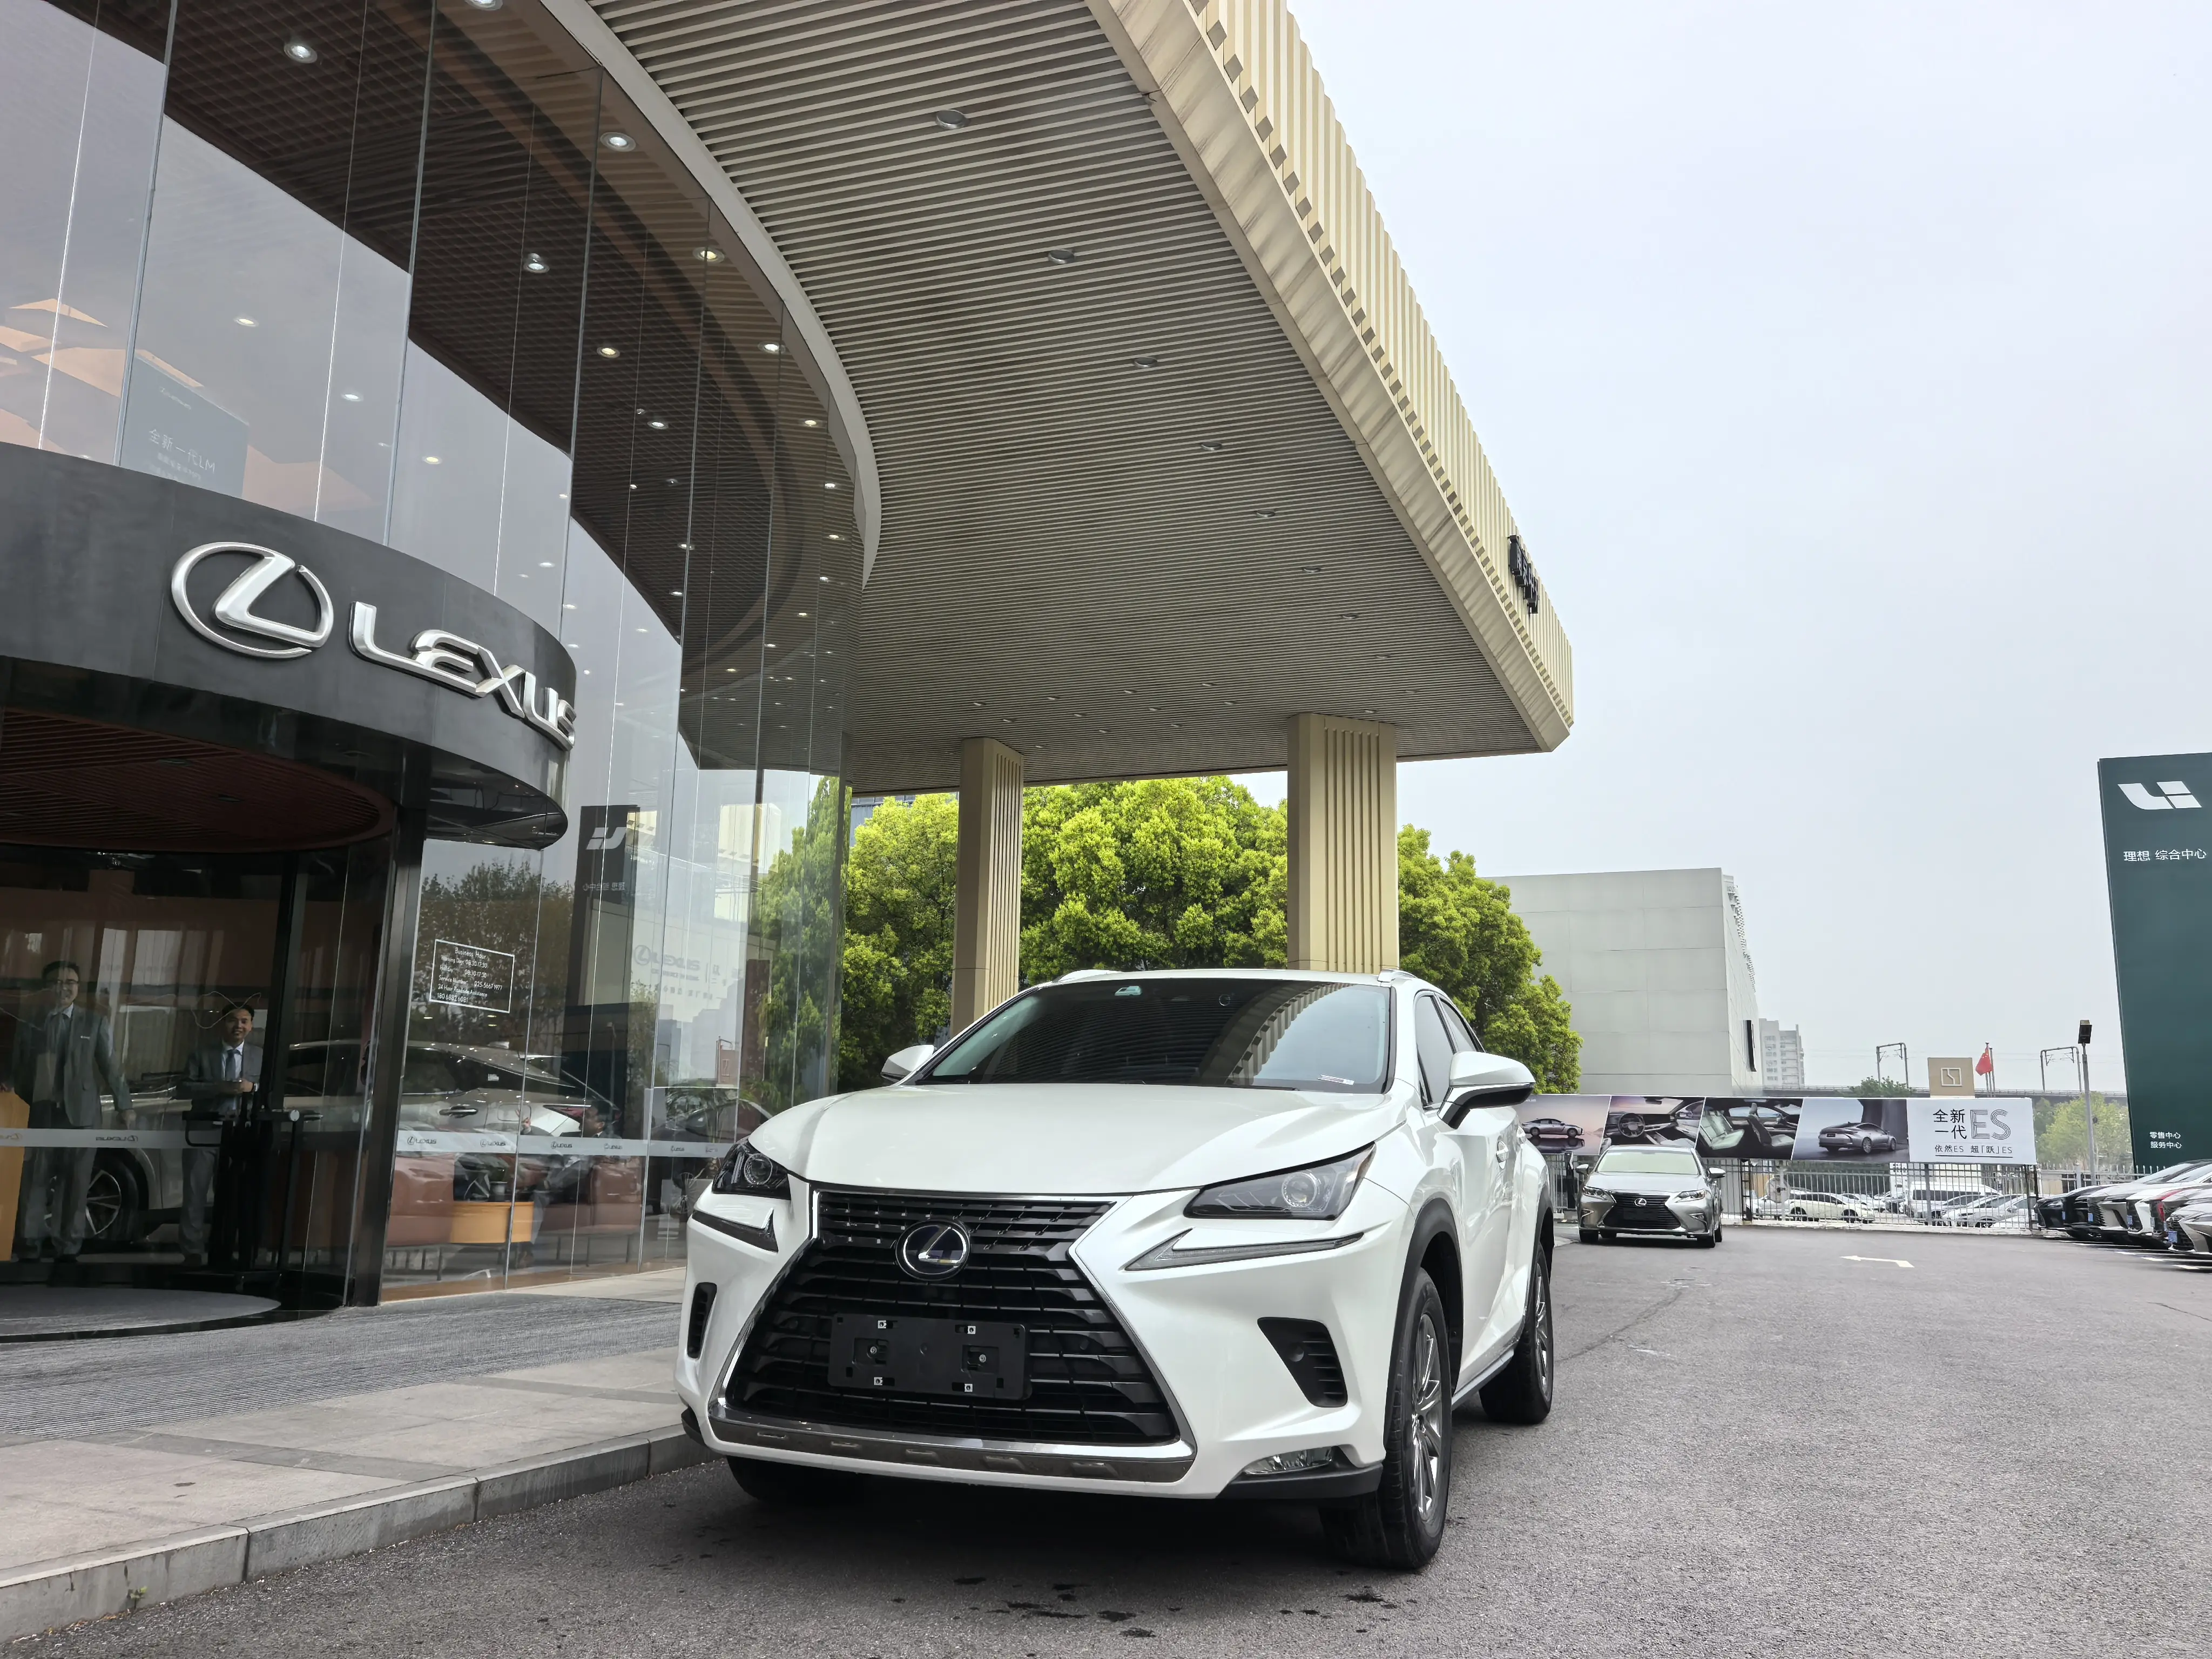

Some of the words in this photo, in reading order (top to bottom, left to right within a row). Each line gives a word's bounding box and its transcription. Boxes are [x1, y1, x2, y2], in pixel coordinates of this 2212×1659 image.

[149, 428, 215, 474] 全新一代LM
[348, 600, 576, 752] LEXUS
[2123, 850, 2150, 862] 理想
[2155, 848, 2207, 861] 综合中心
[455, 947, 474, 957] Business
[439, 974, 452, 982] Service
[1933, 1108, 1965, 1123] 全新
[1970, 1109, 2011, 1140] ES
[1934, 1124, 1967, 1139] 一代
[2149, 1131, 2181, 1139] 零售中心
[2150, 1141, 2182, 1149] 服务中心
